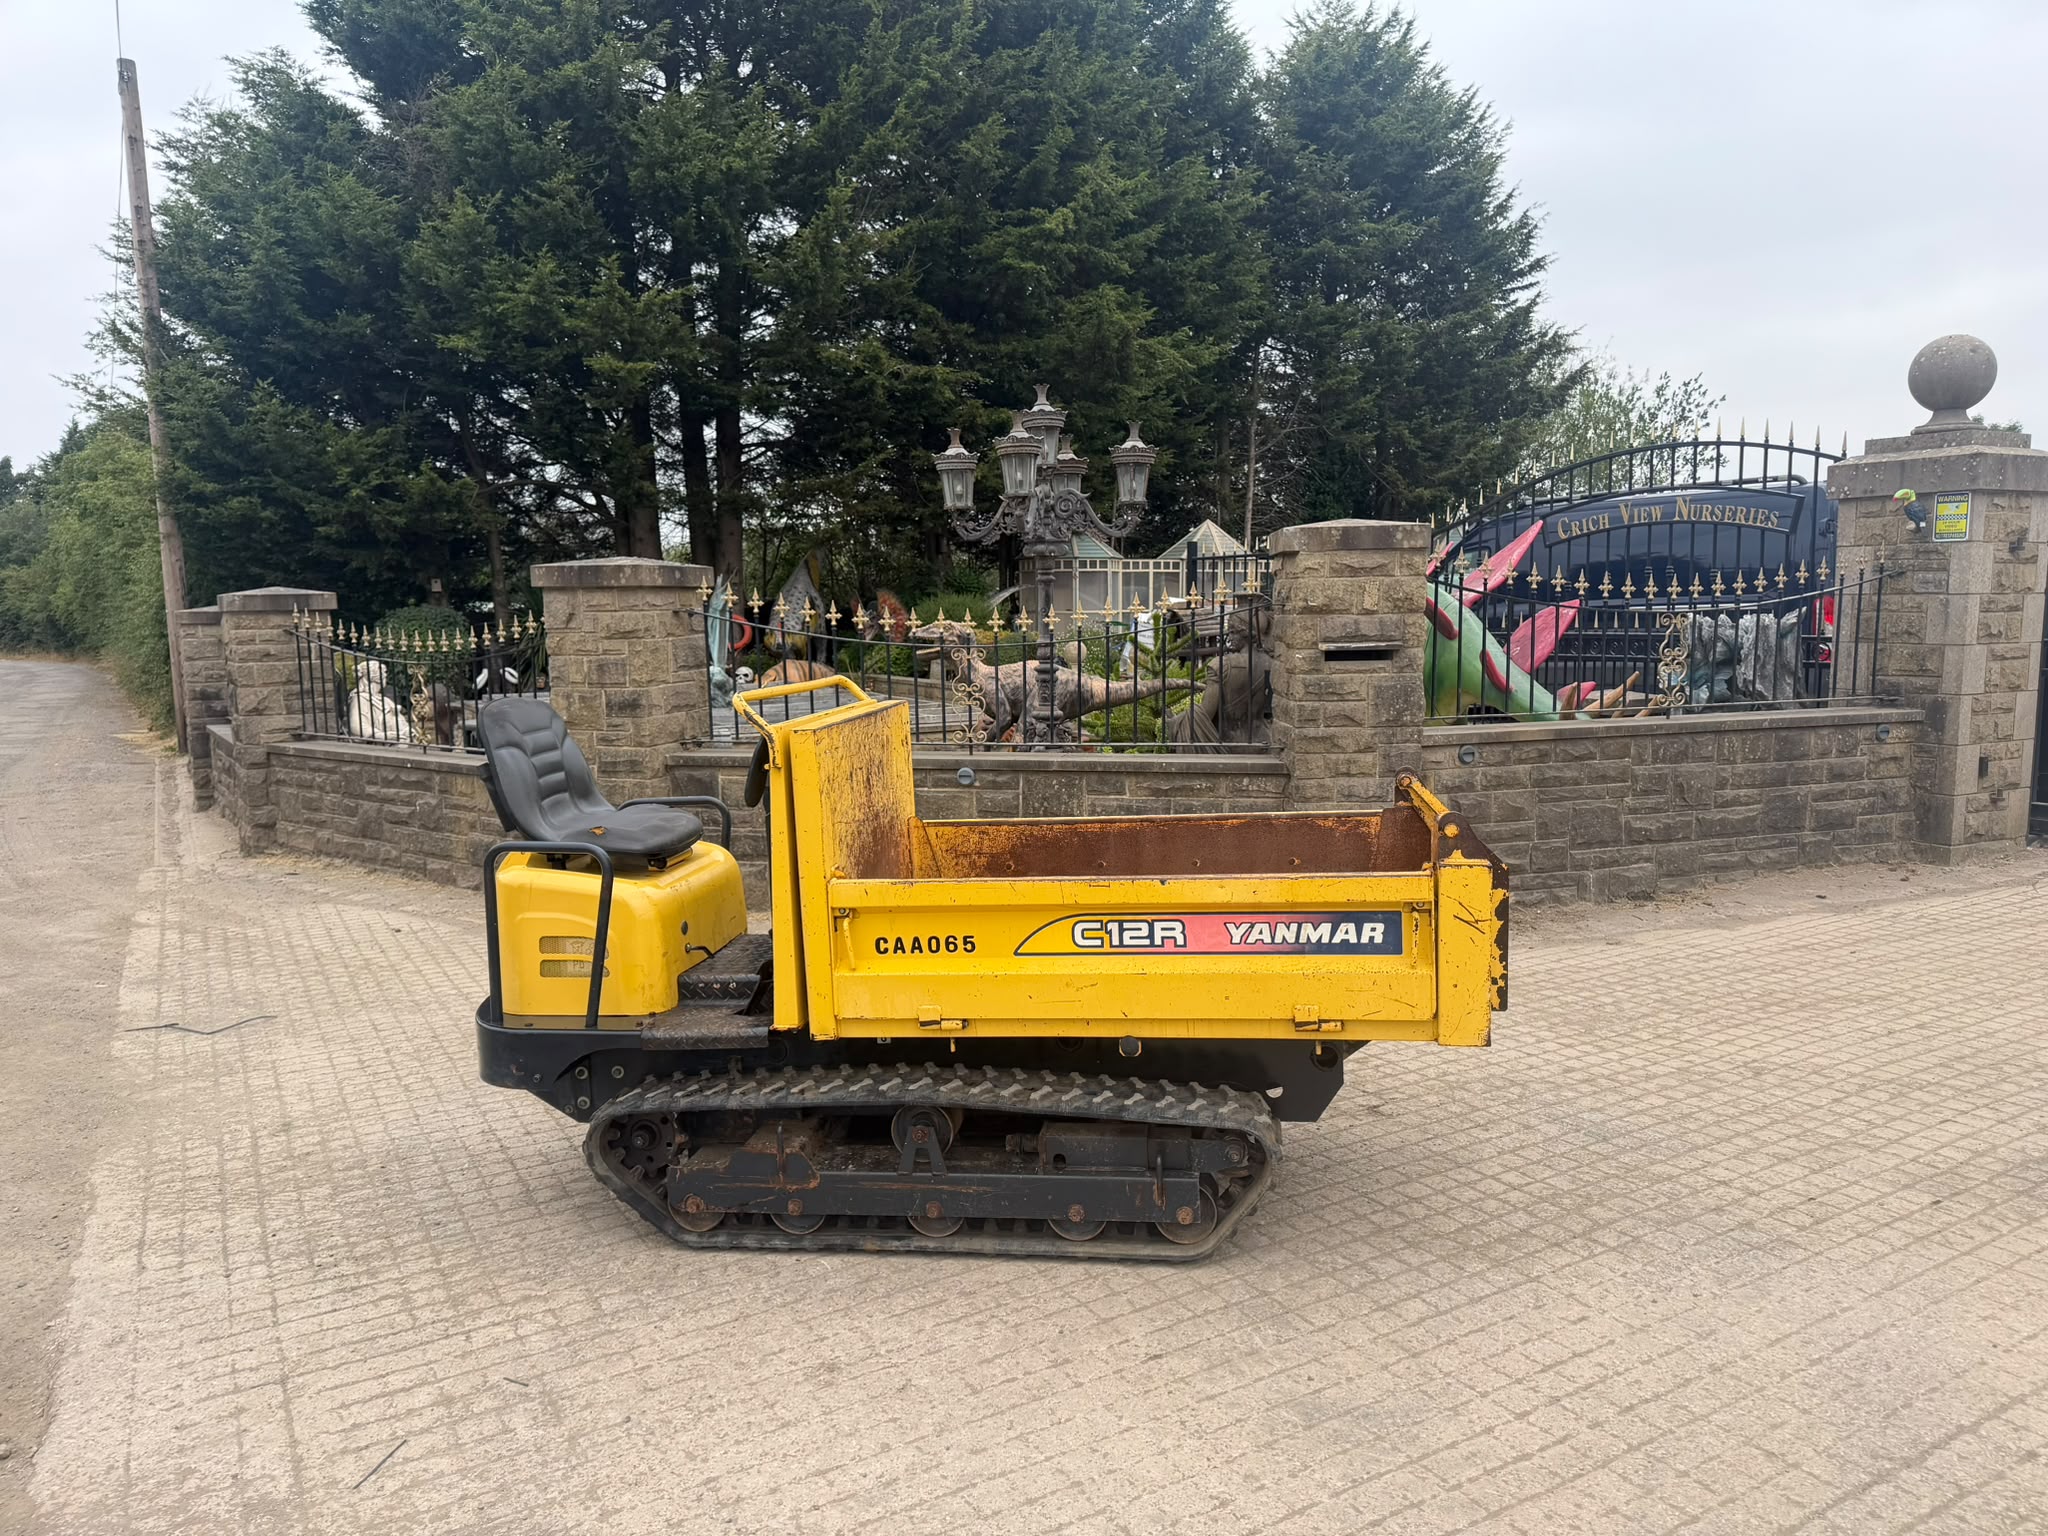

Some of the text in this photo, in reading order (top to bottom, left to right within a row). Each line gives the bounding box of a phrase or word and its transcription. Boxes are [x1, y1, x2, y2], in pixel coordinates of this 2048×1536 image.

[1557, 496, 1780, 540] CRICH VIEW NURSERIES
[874, 935, 976, 955] CAA065
[1072, 920, 1386, 948] C12R YANMAR
